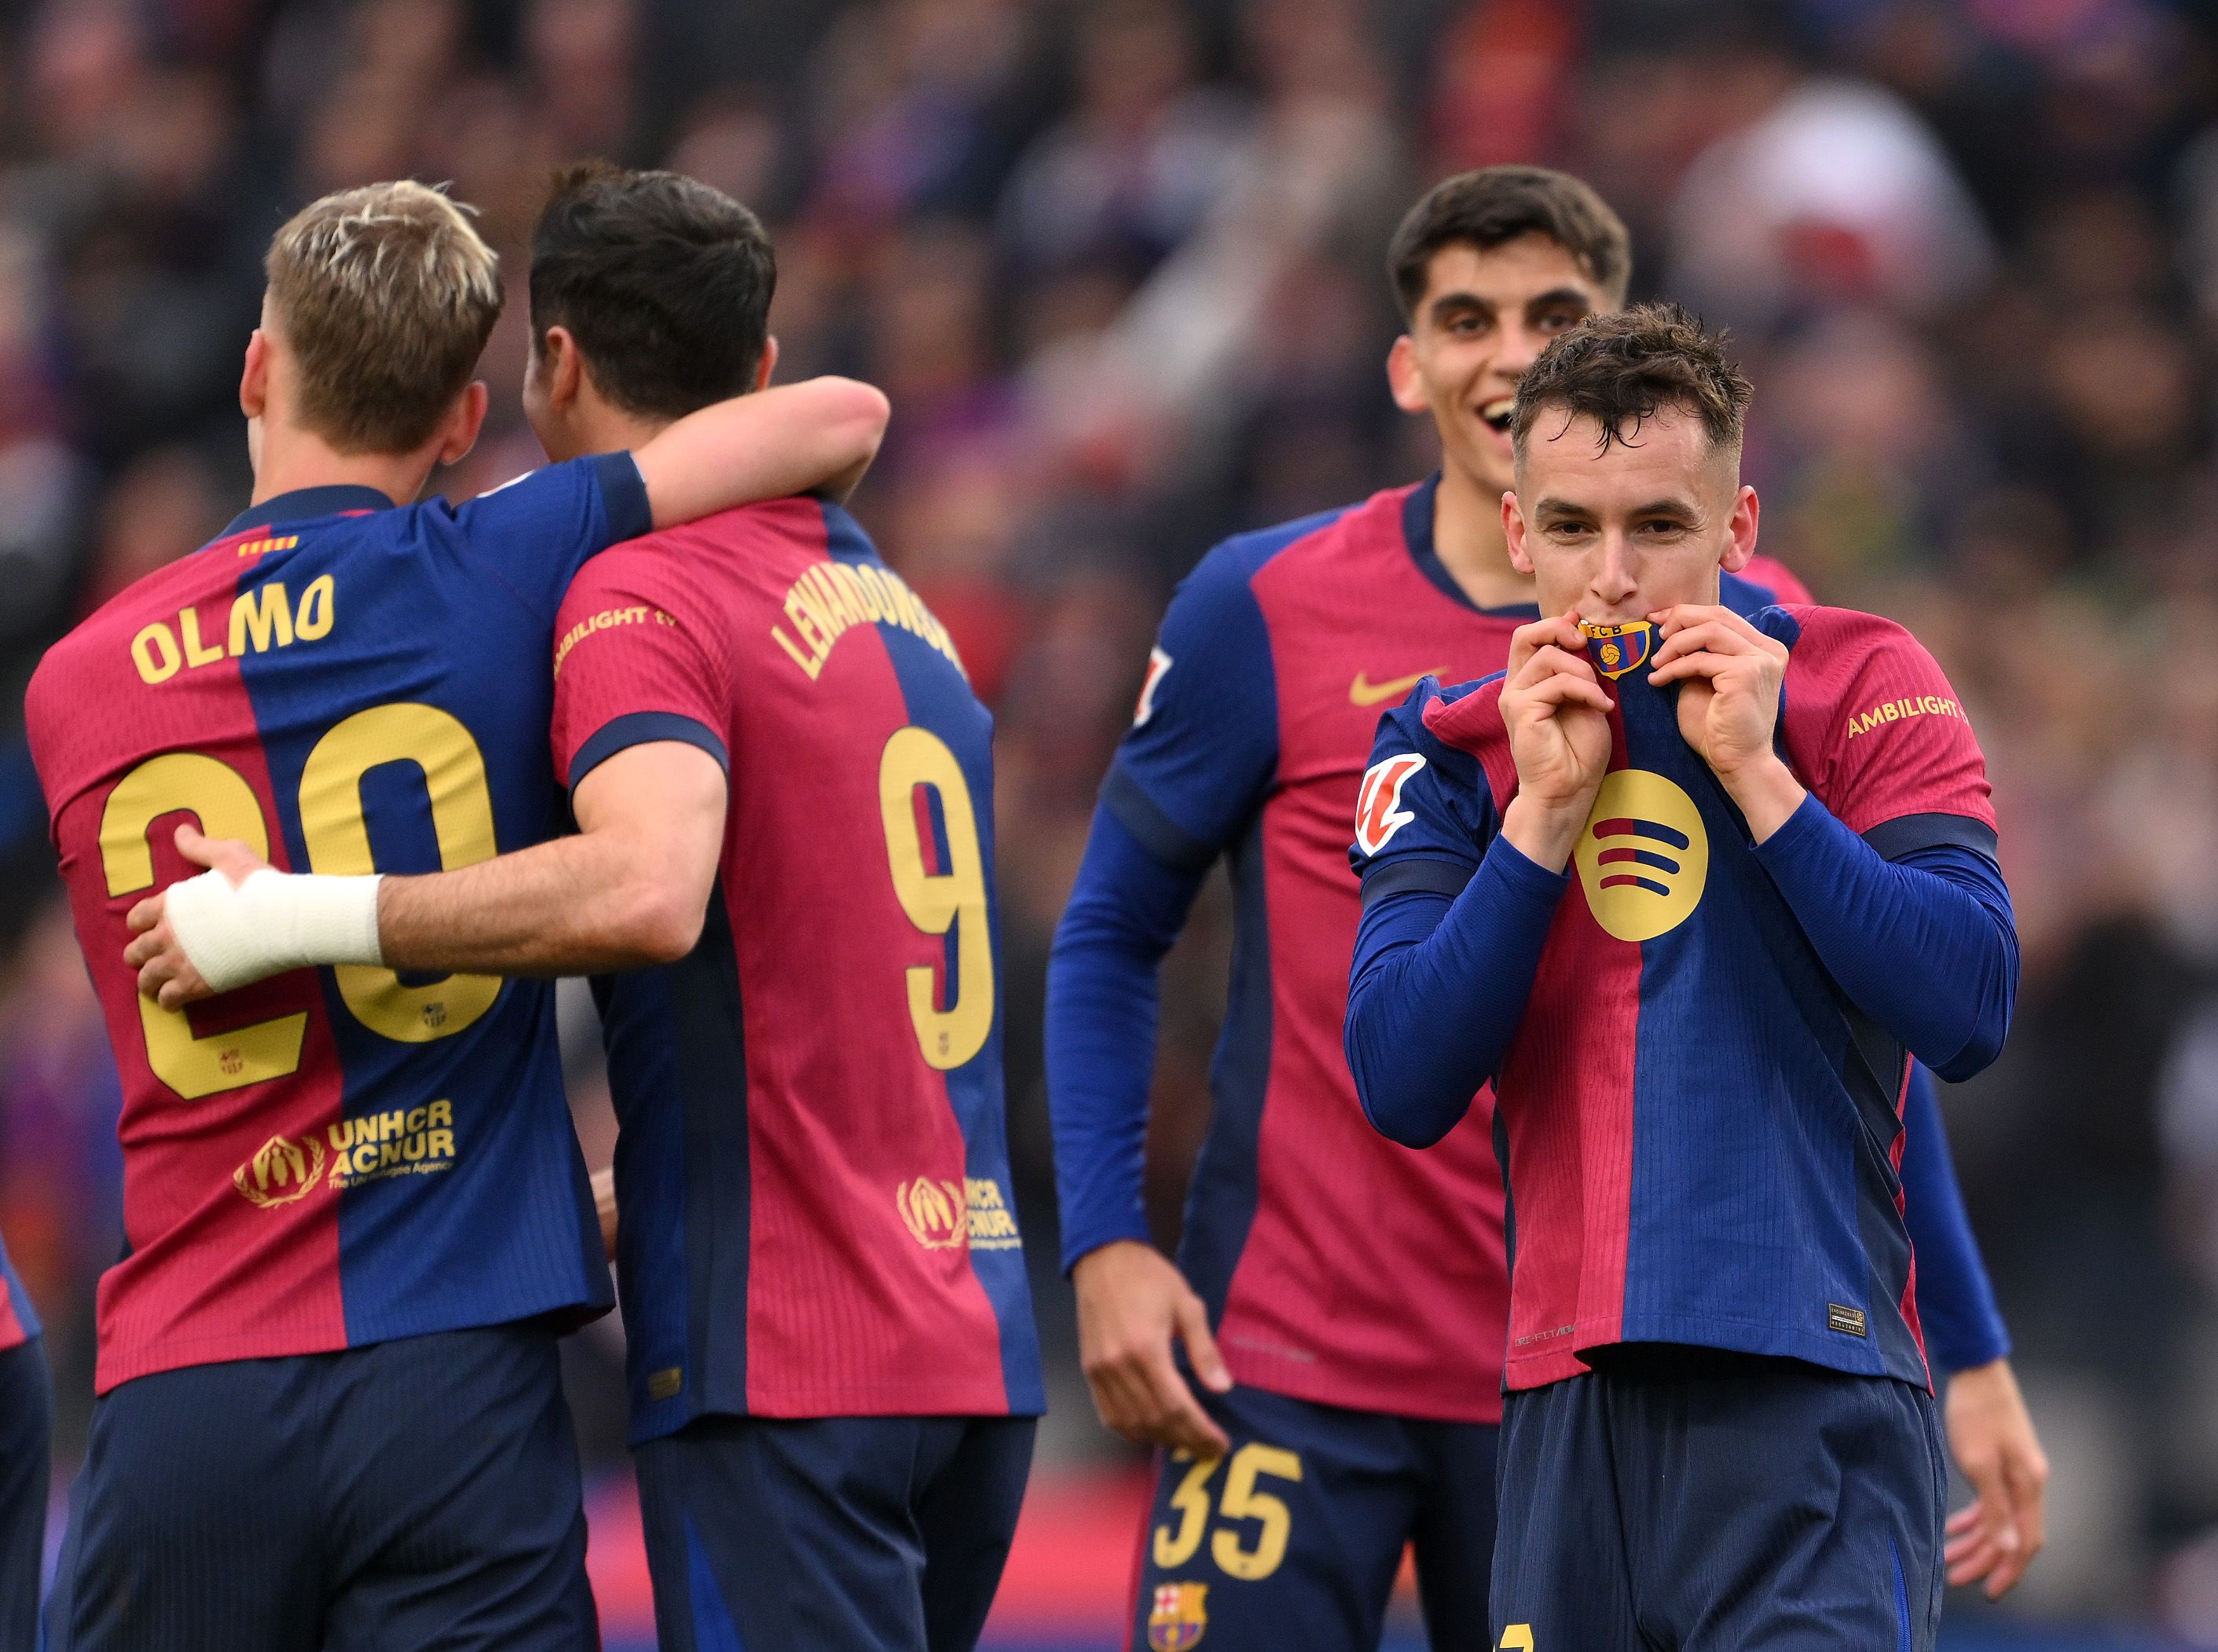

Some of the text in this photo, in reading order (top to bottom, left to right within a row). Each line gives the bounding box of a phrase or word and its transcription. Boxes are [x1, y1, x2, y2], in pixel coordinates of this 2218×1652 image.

[130, 574, 335, 684] OLMO
[1848, 696, 1958, 739] AMBILIGHT
[878, 726, 995, 1071] 9
[328, 1098, 453, 1152] UNHCR
[328, 1129, 455, 1178] ACNUR
[1153, 1442, 1303, 1581] 35
